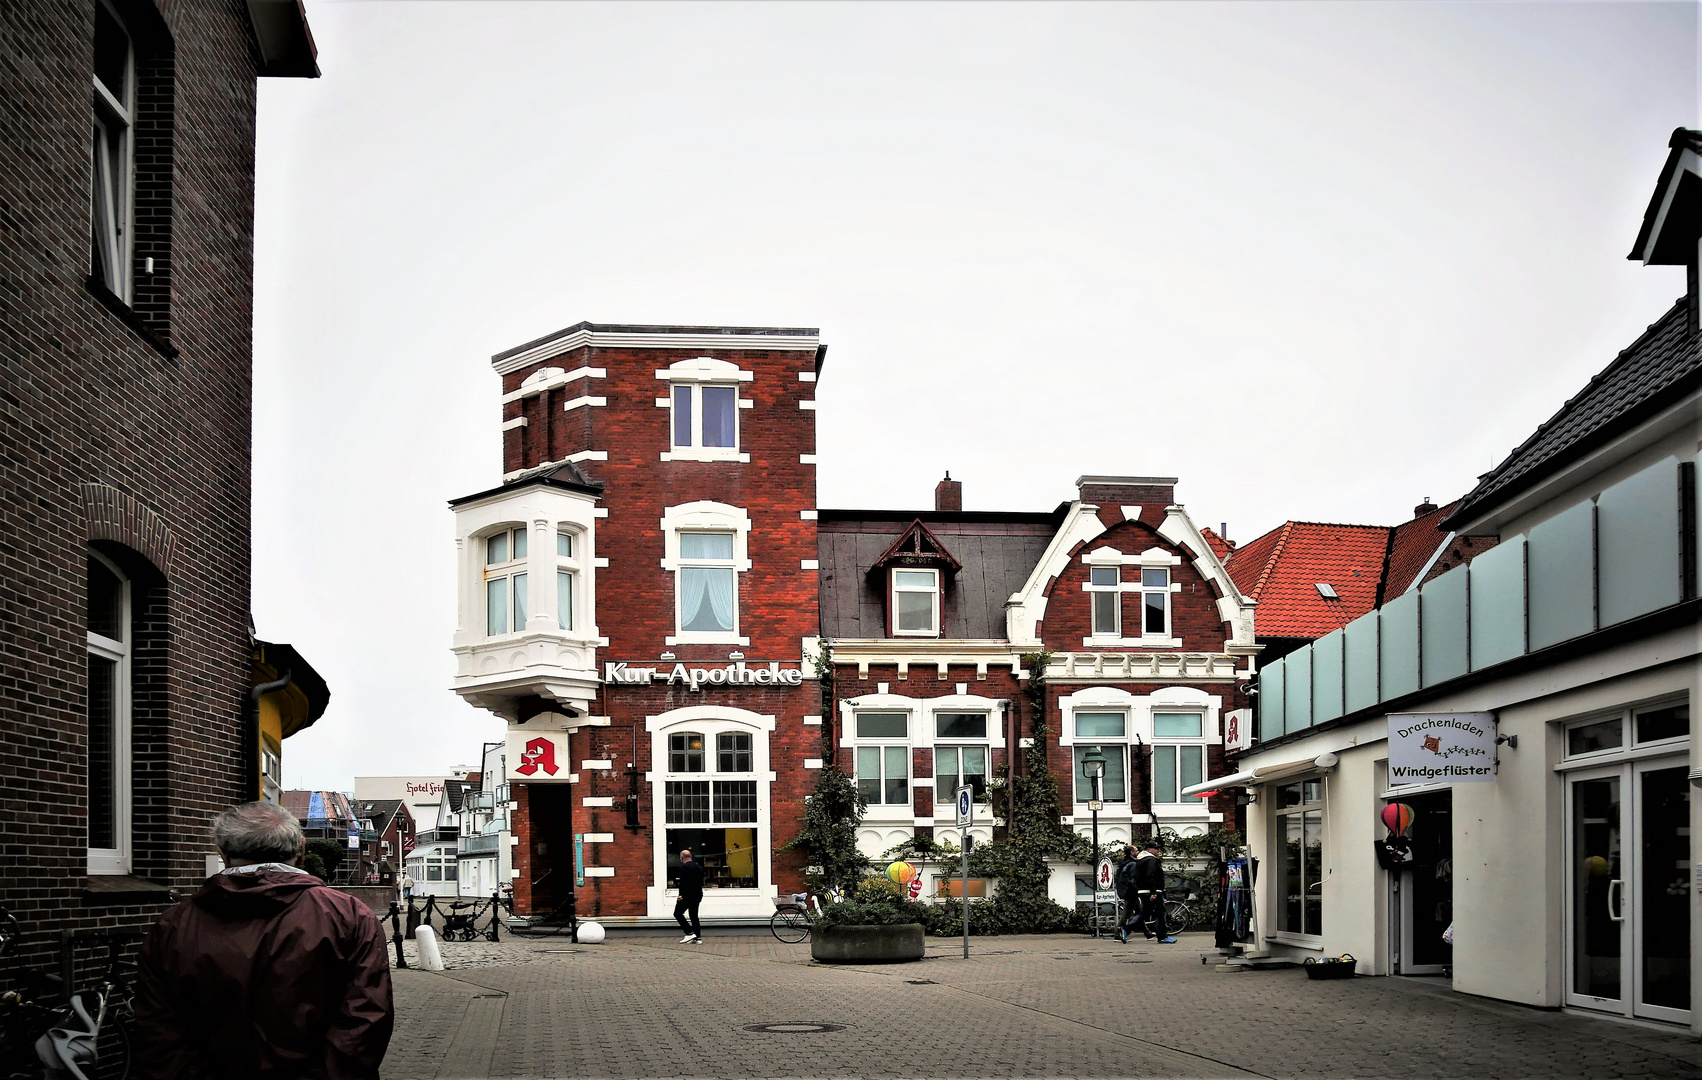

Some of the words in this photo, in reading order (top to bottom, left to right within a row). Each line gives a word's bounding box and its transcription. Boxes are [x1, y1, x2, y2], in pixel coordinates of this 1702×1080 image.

[604, 661, 803, 692] Kur-Apotheke
[1397, 718, 1484, 738] Drachenladen
[1392, 765, 1491, 779] Windgeflüster
[406, 781, 428, 796] Hotel
